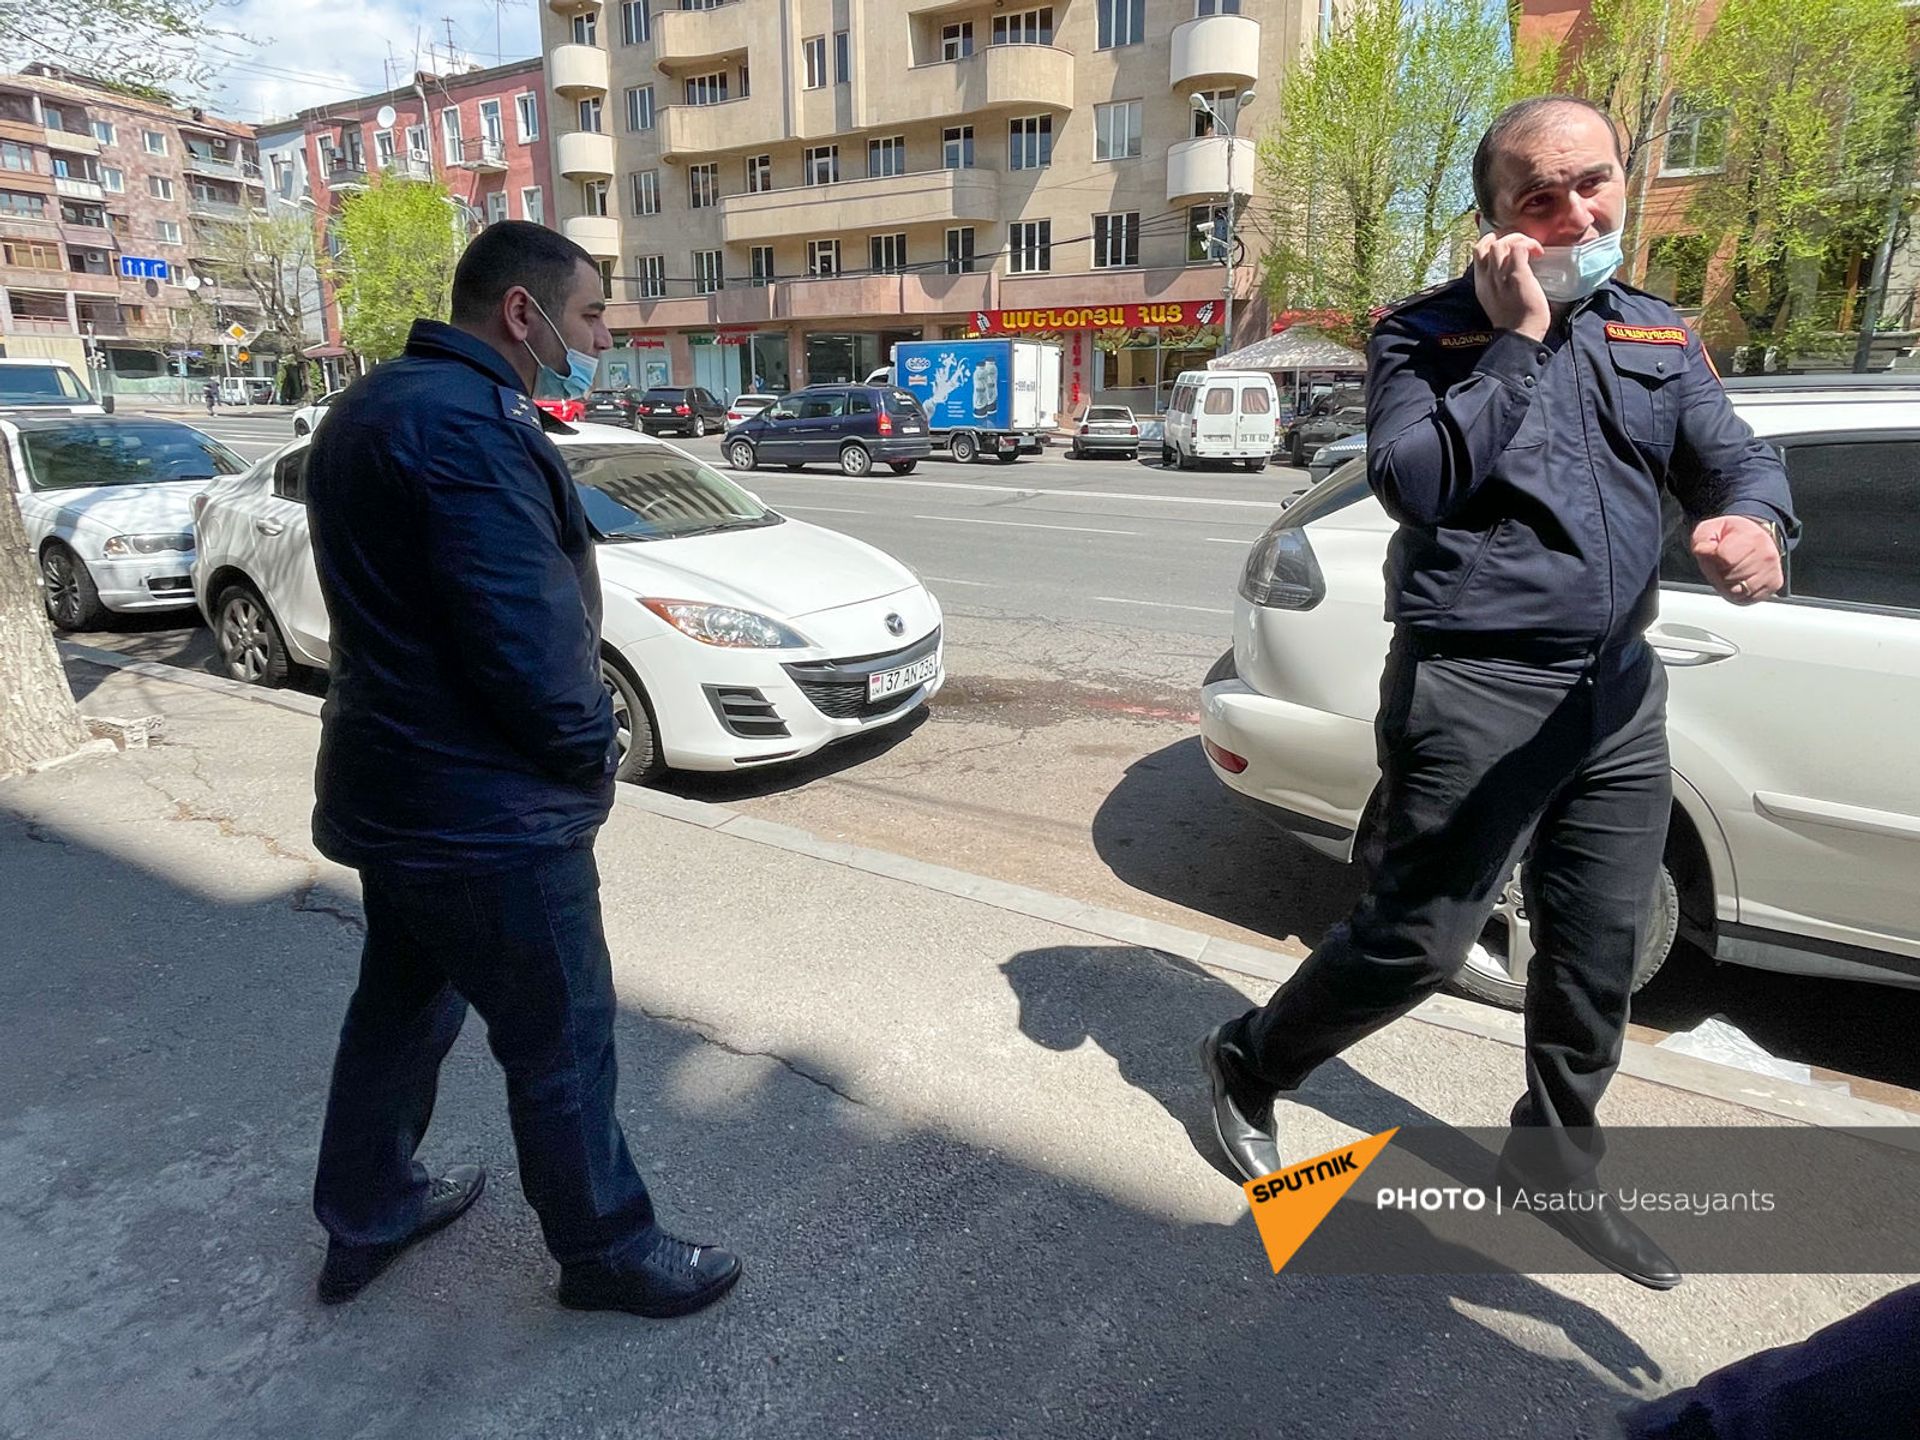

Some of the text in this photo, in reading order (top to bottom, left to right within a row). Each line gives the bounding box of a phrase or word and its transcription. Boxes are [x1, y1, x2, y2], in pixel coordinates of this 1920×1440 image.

[1002, 304, 1183, 329] ԱՄԵՆՕՐՅԱ ՀԱՑ
[886, 671, 900, 691] 37
[903, 665, 918, 687] AN
